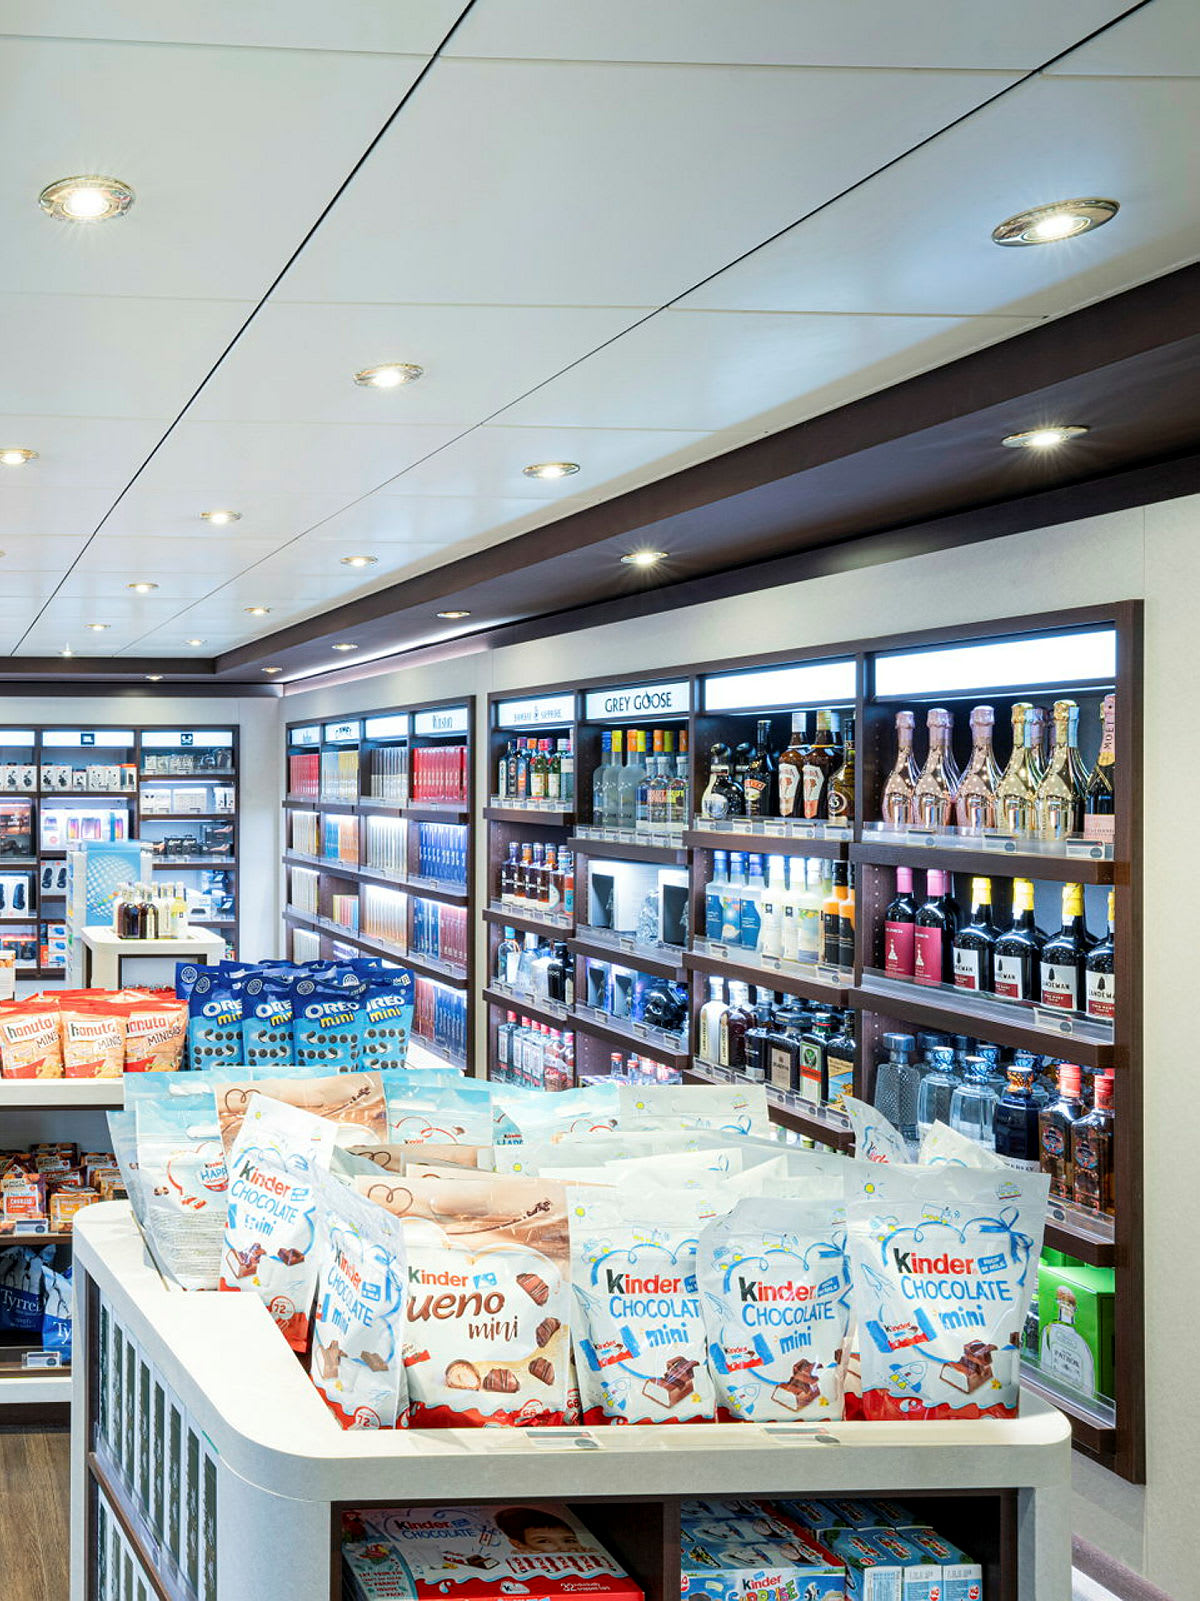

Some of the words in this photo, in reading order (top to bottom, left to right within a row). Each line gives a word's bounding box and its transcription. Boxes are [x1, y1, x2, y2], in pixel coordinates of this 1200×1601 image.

[605, 696, 631, 712] GREY
[634, 692, 671, 709] GOOSE
[203, 999, 242, 1017] ORE
[256, 1000, 292, 1018] ORE
[305, 1001, 359, 1018] OREO
[370, 1007, 401, 1022] mini
[7, 1017, 53, 1039] hanuta
[321, 1012, 354, 1028] mini
[200, 1167, 228, 1180] HAPP
[231, 1180, 299, 1224] CHOCOLATE
[901, 1276, 1013, 1301] CHOCOLATE
[274, 1303, 286, 1314] 72
[407, 1291, 505, 1322] ueno
[610, 1296, 700, 1318] CHOCOLAT
[742, 1301, 835, 1326] CHOCOLATE
[940, 1304, 986, 1330] mini
[468, 1315, 518, 1342] mini
[645, 1322, 690, 1348] mini
[780, 1325, 811, 1354] mini
[357, 1415, 371, 1427] 72
[402, 1528, 477, 1539] CHOCOLATE
